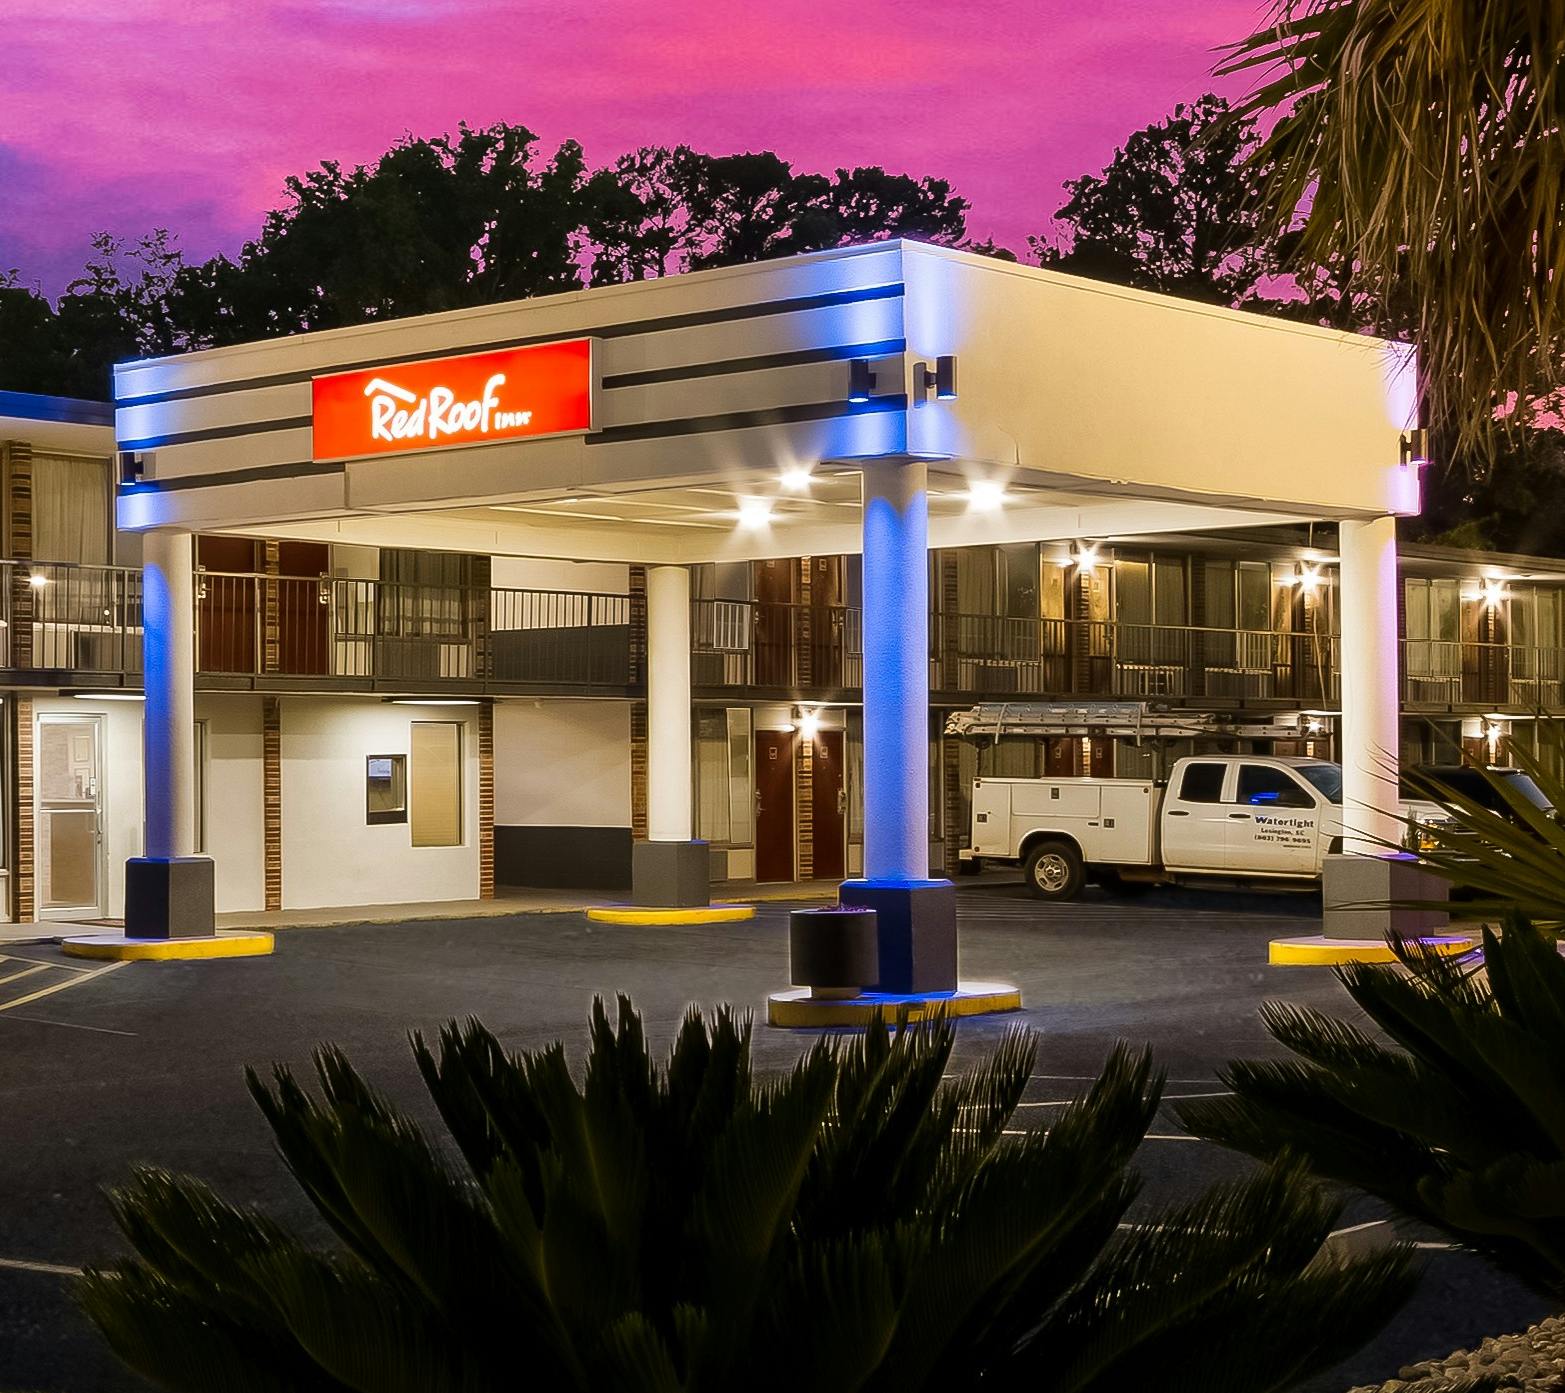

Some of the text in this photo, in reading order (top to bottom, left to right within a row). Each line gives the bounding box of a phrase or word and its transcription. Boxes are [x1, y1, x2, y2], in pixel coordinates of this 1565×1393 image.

[371, 394, 427, 441] Red
[428, 373, 506, 439] Roof
[1255, 817, 1313, 828] Watertight
